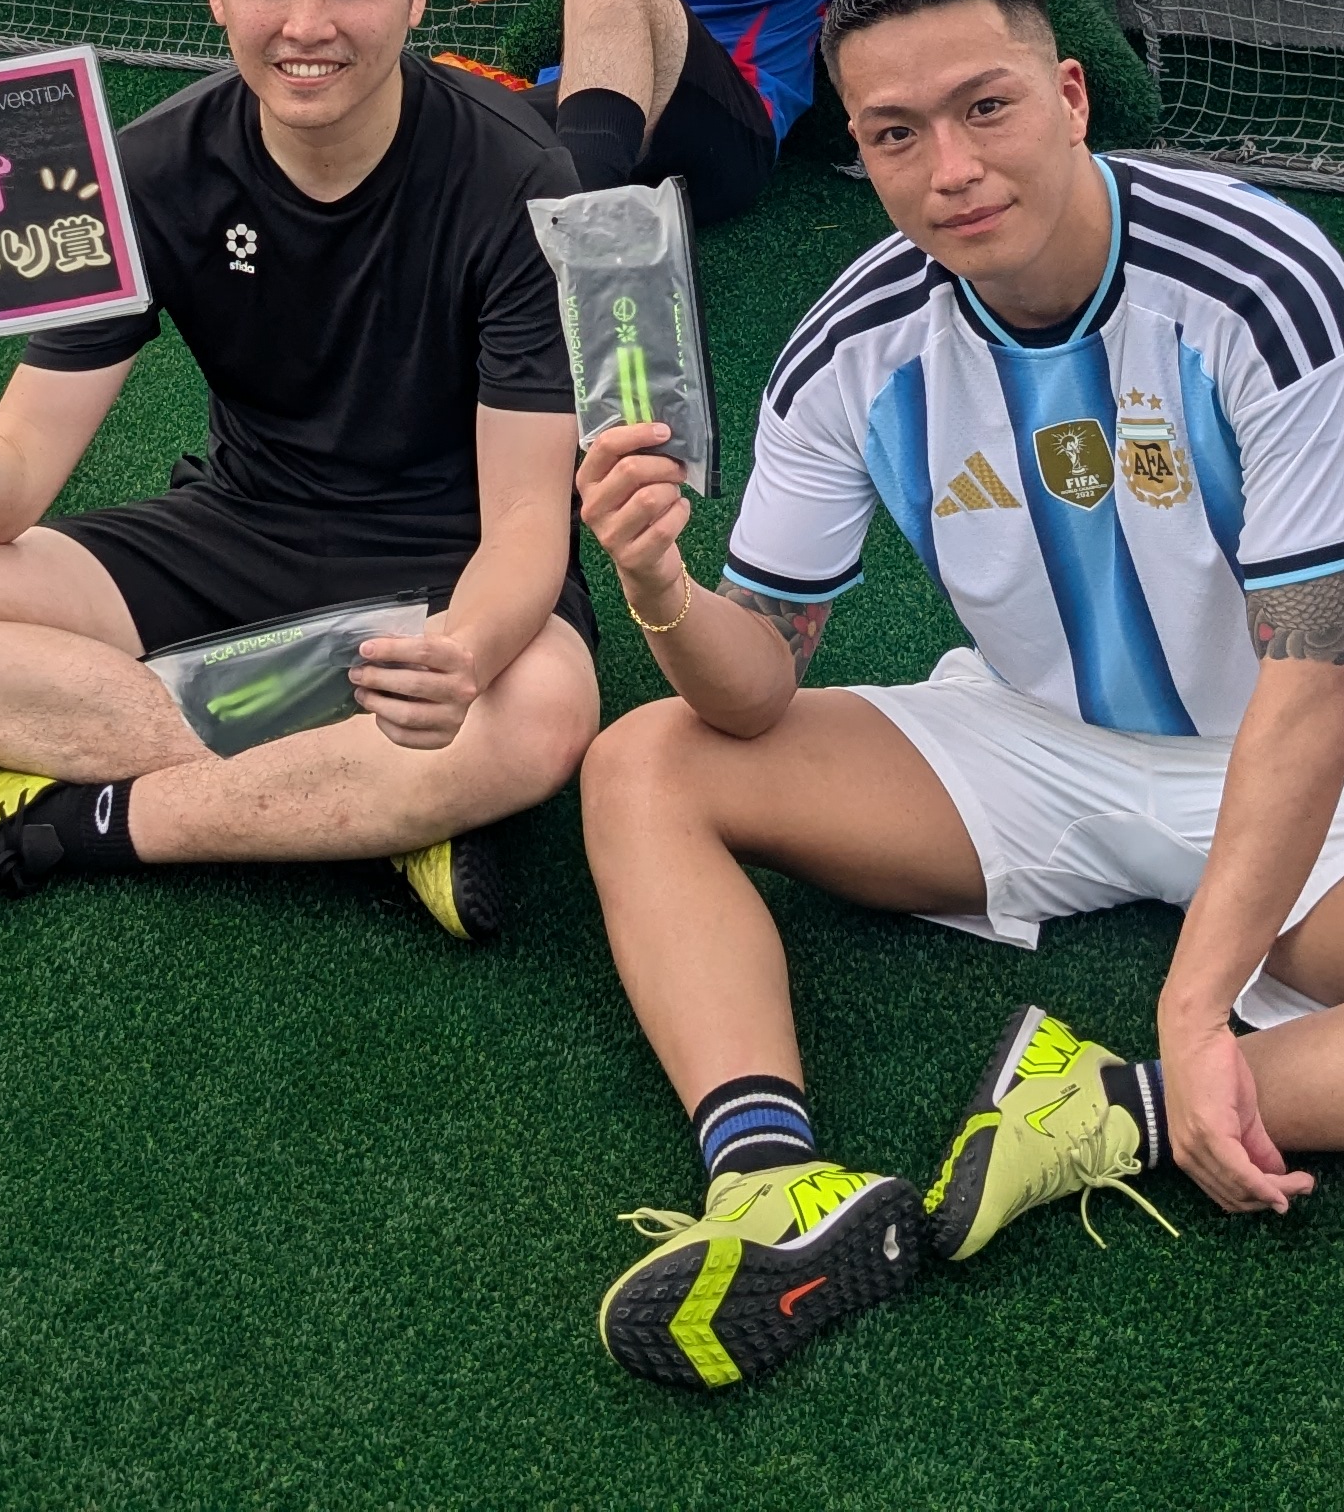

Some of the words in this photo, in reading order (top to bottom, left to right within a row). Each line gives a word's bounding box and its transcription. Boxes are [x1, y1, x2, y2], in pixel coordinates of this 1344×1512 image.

[229, 260, 255, 274] sfida
[1134, 442, 1173, 483] AFA
[1066, 474, 1099, 489] FIFA
[1075, 490, 1096, 500] 2022
